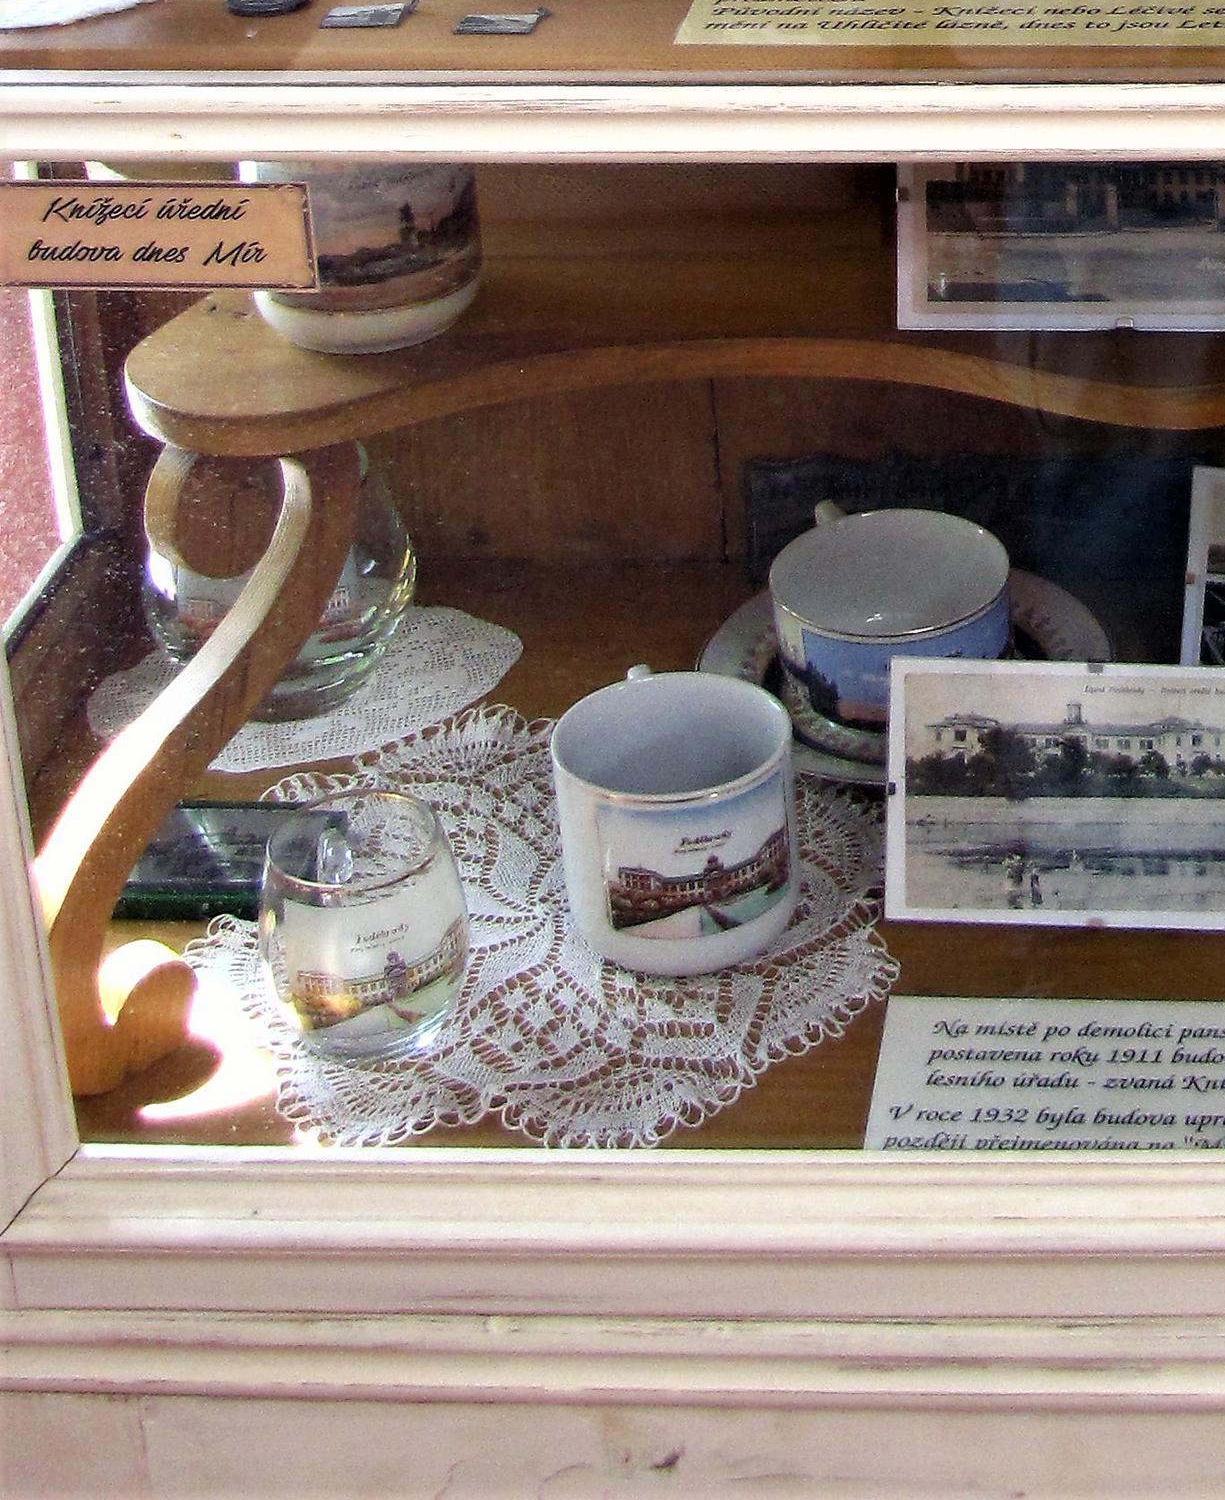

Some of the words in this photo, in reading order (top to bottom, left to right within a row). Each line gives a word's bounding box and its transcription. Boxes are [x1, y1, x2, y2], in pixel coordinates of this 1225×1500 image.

[712, 6, 823, 16] Původní
[828, 7, 906, 16] název
[931, 6, 1037, 16] Knížecí
[1043, 5, 1102, 15] nebo
[1106, 5, 1196, 15] Léčivé
[704, 20, 771, 30] mění
[817, 19, 929, 30] Uhličité
[935, 19, 1009, 30] lázně,
[1019, 19, 1076, 30] dnes
[1085, 20, 1110, 29] to
[1110, 20, 1170, 32] jsou
[43, 197, 152, 225] Knížecí
[157, 198, 250, 221] úřední
[28, 239, 124, 262] budova
[132, 240, 189, 263] dnes
[202, 240, 268, 266] Mír
[933, 1020, 969, 1038] Na
[974, 1022, 1038, 1037] místě
[1042, 1025, 1071, 1042] po
[1078, 1020, 1172, 1039] demolici
[926, 1049, 1042, 1066] postavena
[1106, 1048, 1163, 1063] 1911
[925, 1069, 1006, 1087] lesního
[1012, 1070, 1080, 1089] úřadu
[1103, 1075, 1176, 1089] zvaná
[889, 1104, 914, 1121] V
[916, 1109, 963, 1122] roce
[969, 1107, 1029, 1123] 1932
[1035, 1107, 1087, 1130] byla
[1093, 1107, 1178, 1126] budova
[1149, 1139, 1176, 1150] na
